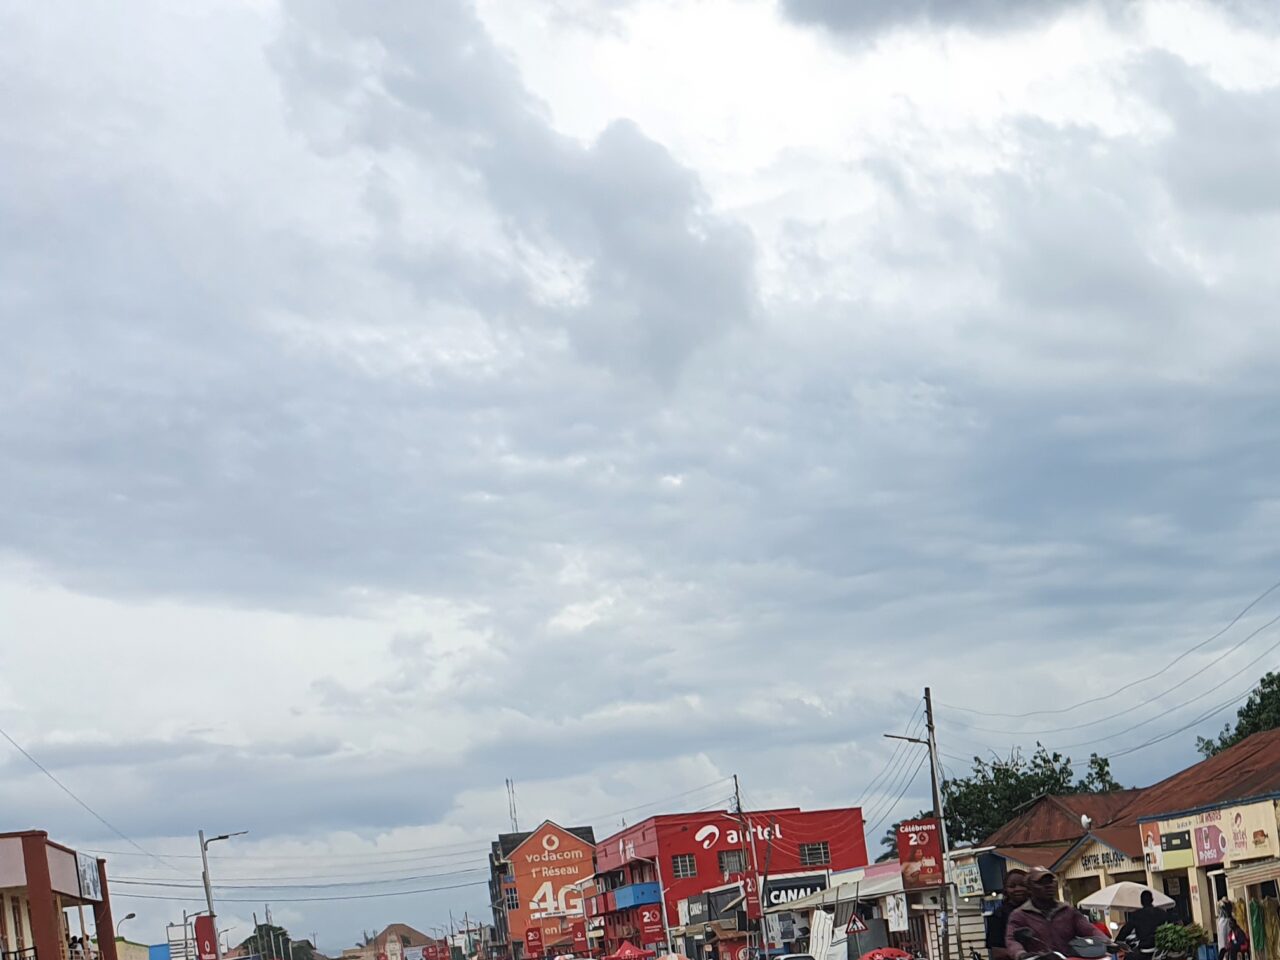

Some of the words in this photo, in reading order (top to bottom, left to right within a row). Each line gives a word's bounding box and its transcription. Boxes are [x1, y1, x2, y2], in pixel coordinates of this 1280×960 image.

[726, 823, 783, 844] airtel
[900, 823, 936, 833] Célébrons
[525, 849, 583, 863] vodacom
[542, 865, 579, 877] Réseau
[529, 881, 584, 915] 4G
